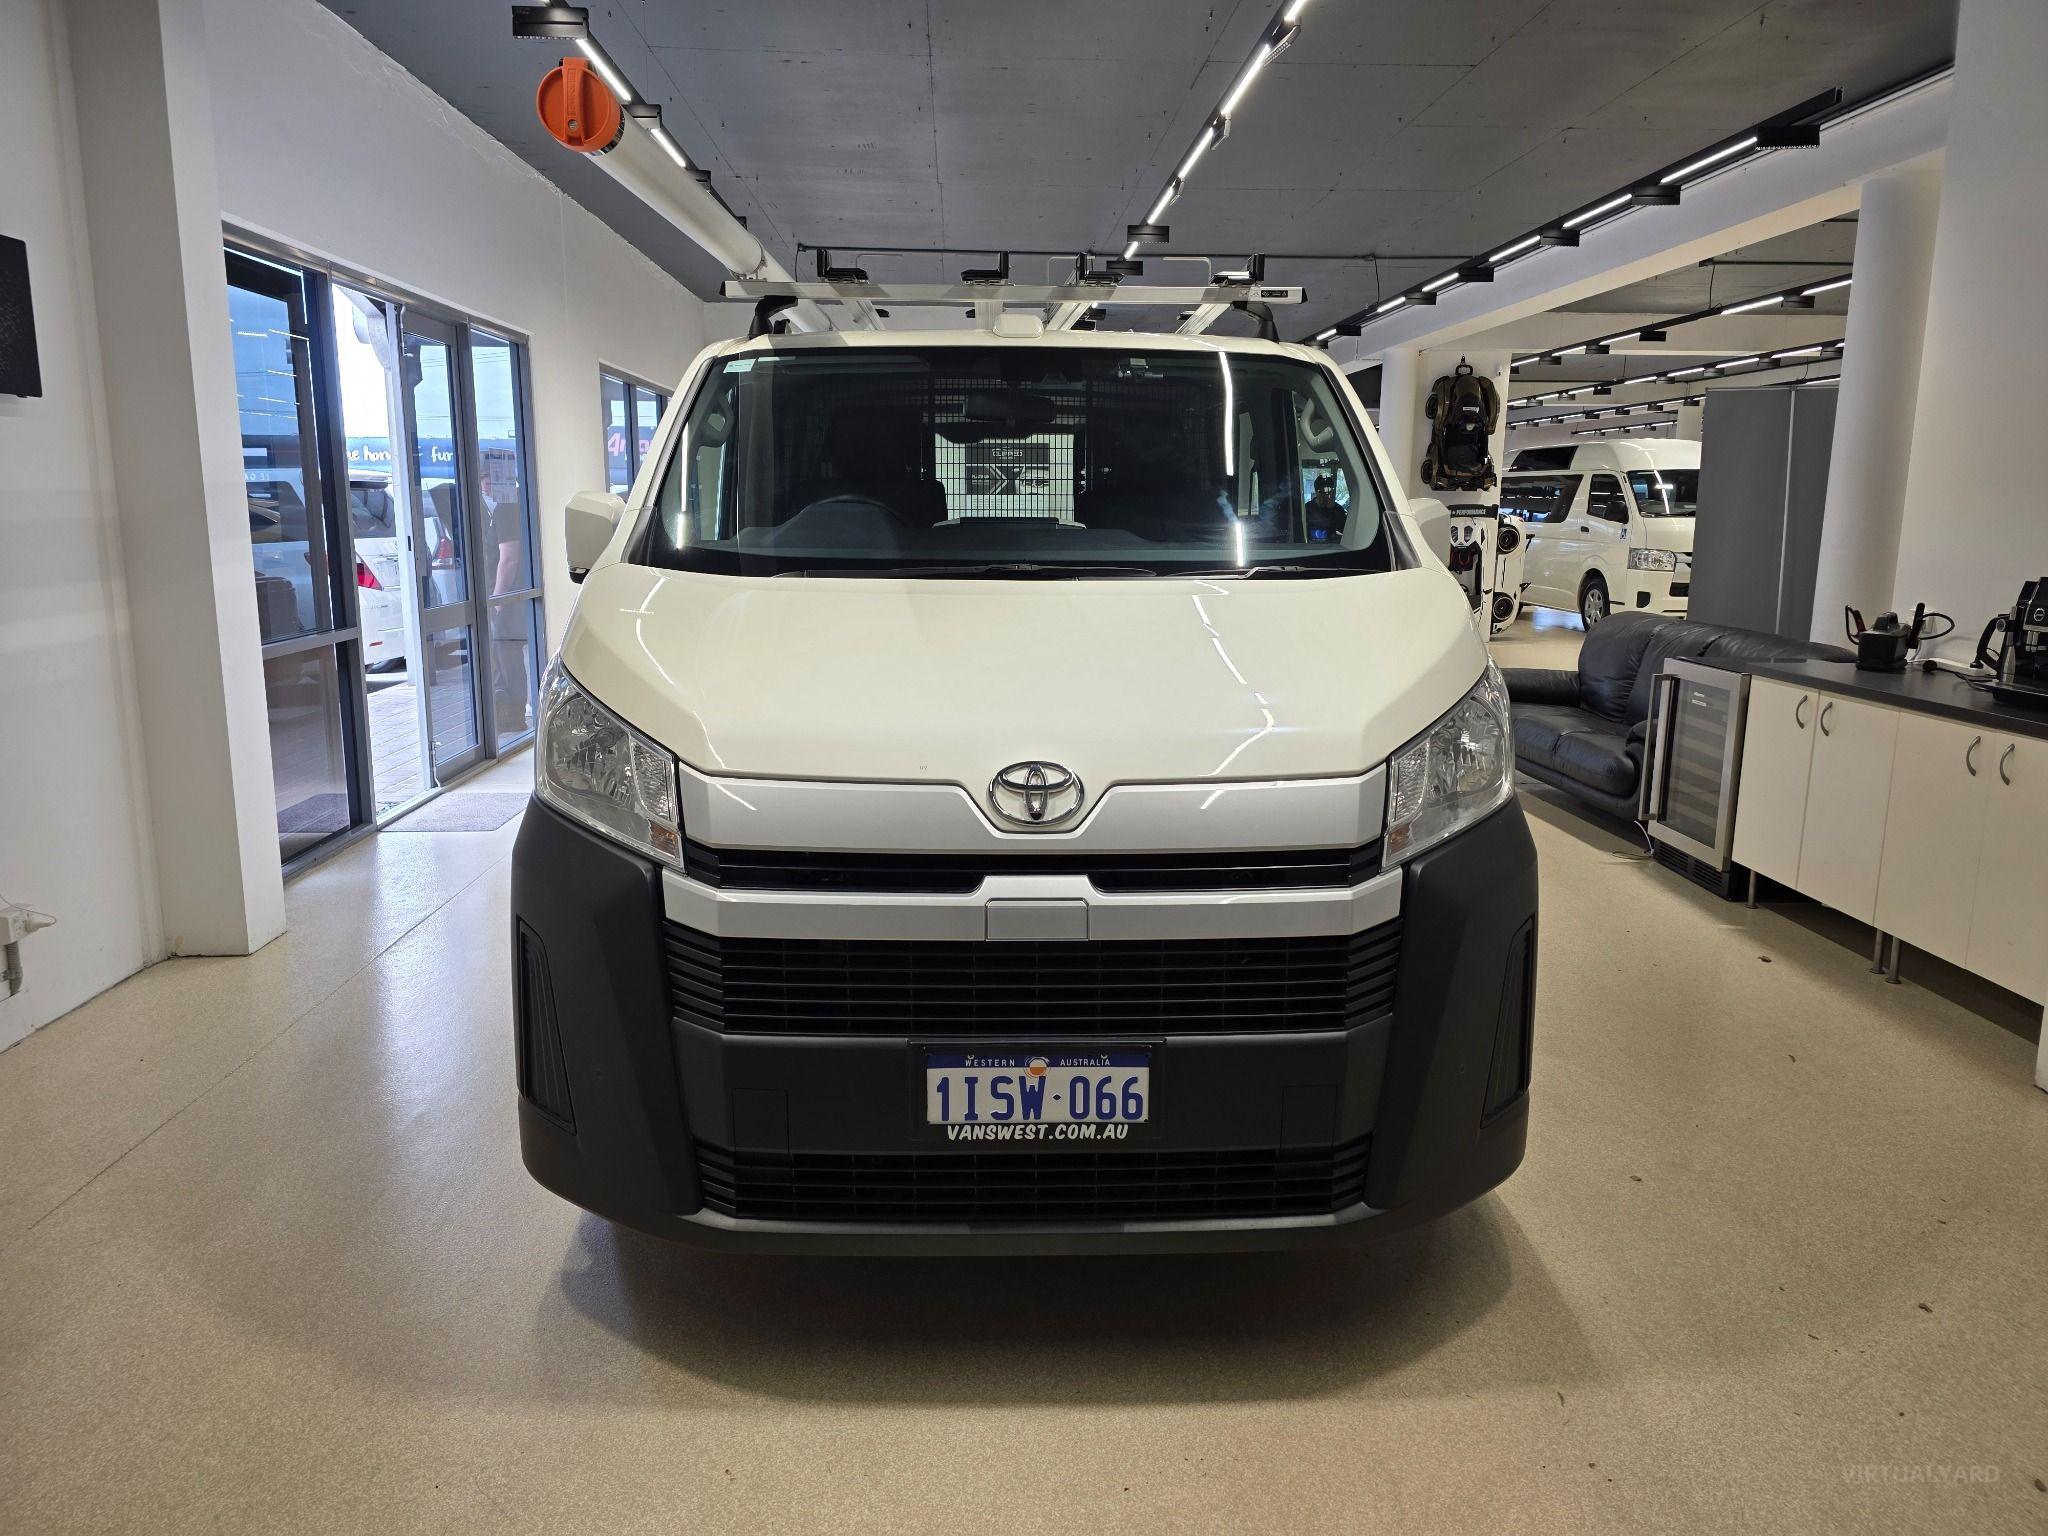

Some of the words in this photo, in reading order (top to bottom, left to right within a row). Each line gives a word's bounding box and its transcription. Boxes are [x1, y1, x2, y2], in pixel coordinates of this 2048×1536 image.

[965, 1058, 1016, 1068] WESTERN
[1060, 1057, 1111, 1067] AUSTRALIA
[947, 1123, 1129, 1141] VANSWEST.COM.AU
